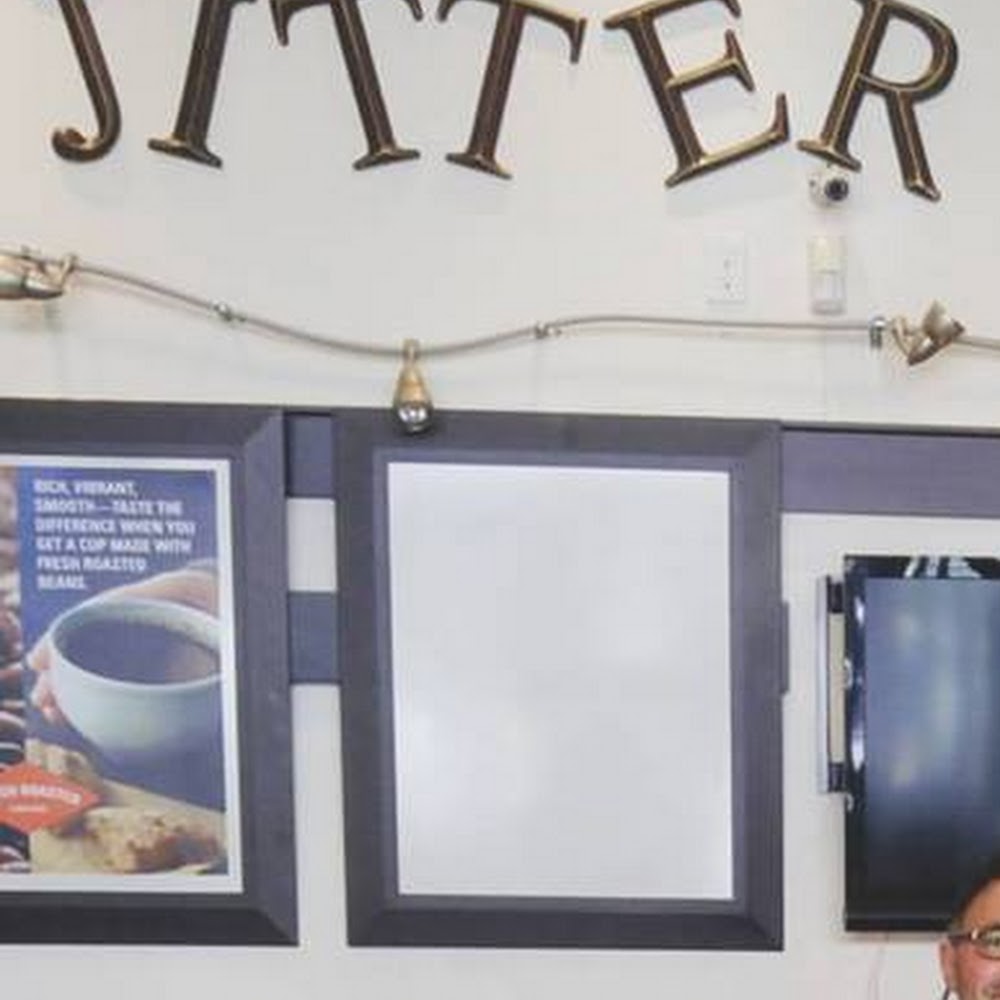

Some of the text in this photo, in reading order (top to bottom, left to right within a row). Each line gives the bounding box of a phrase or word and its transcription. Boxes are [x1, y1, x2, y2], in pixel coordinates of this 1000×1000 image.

[51, 0, 958, 200] JITTER
[158, 501, 183, 515] THE
[35, 517, 196, 536] DIFFERENCE WHEN YOU
[36, 536, 192, 554] GET A CUP MADE WITH
[37, 555, 147, 573] FRESH ROASTED
